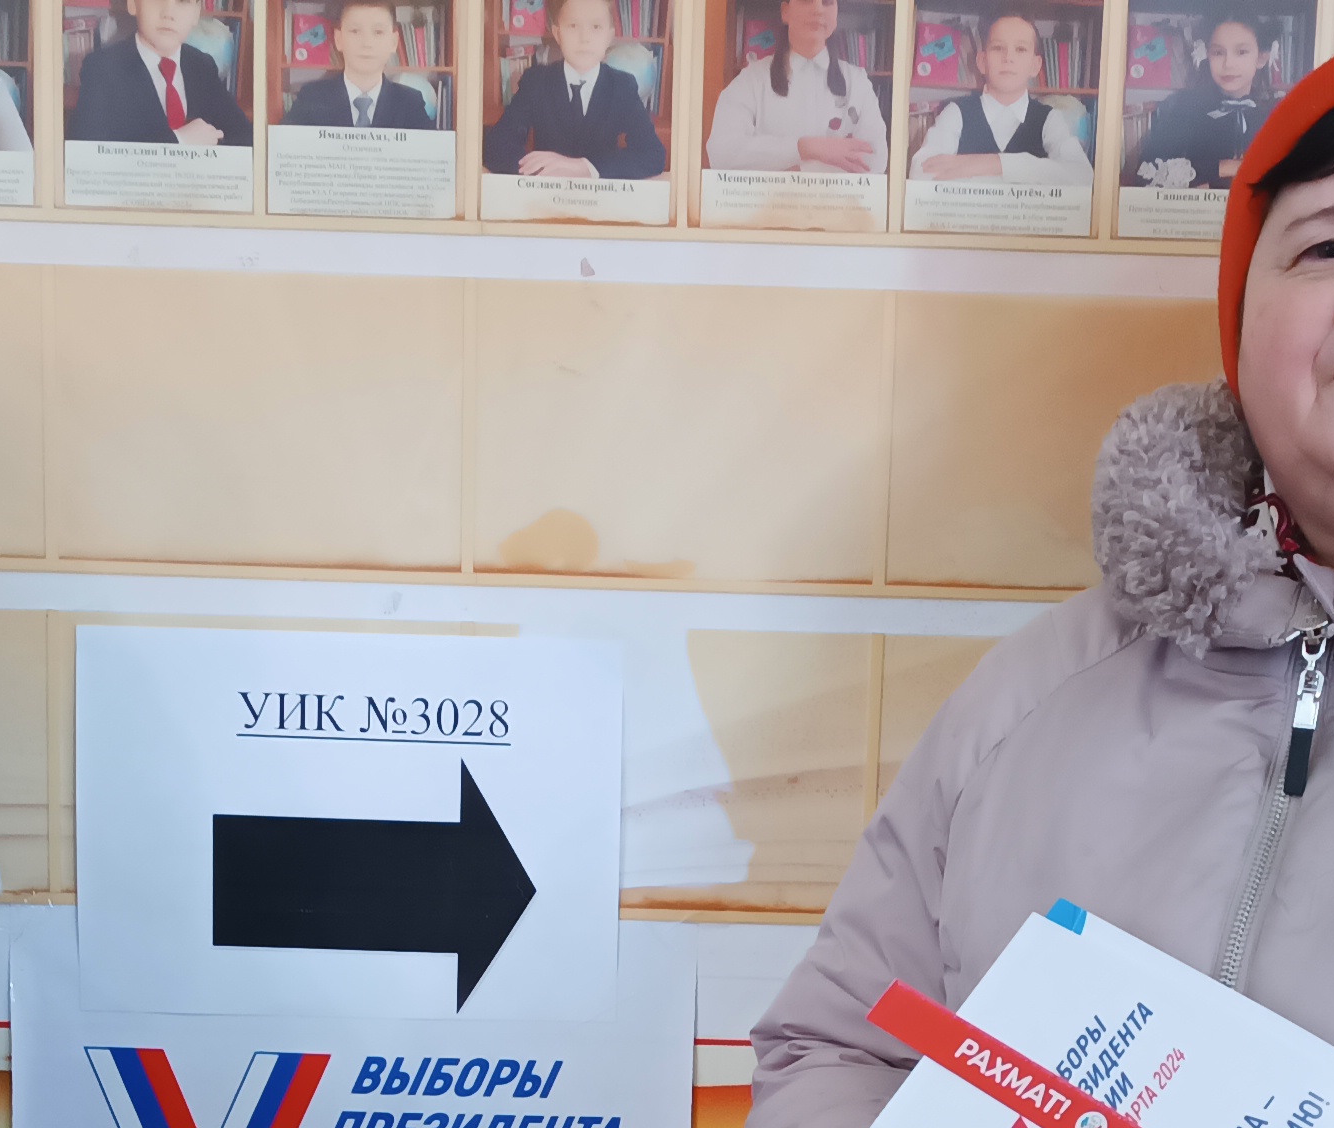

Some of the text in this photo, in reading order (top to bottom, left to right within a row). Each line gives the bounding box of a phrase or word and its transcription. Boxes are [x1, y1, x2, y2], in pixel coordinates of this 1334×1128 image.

[238, 691, 510, 738] УИК №3028
[351, 1056, 564, 1099] ВЫБОРЫ
[954, 1039, 1072, 1120] РАХМАТ!
[1056, 1015, 1107, 1081] БОРЫ
[1078, 1002, 1154, 1097] ЗИДЕНТА
[1125, 1047, 1186, 1124] АРТА 2024
